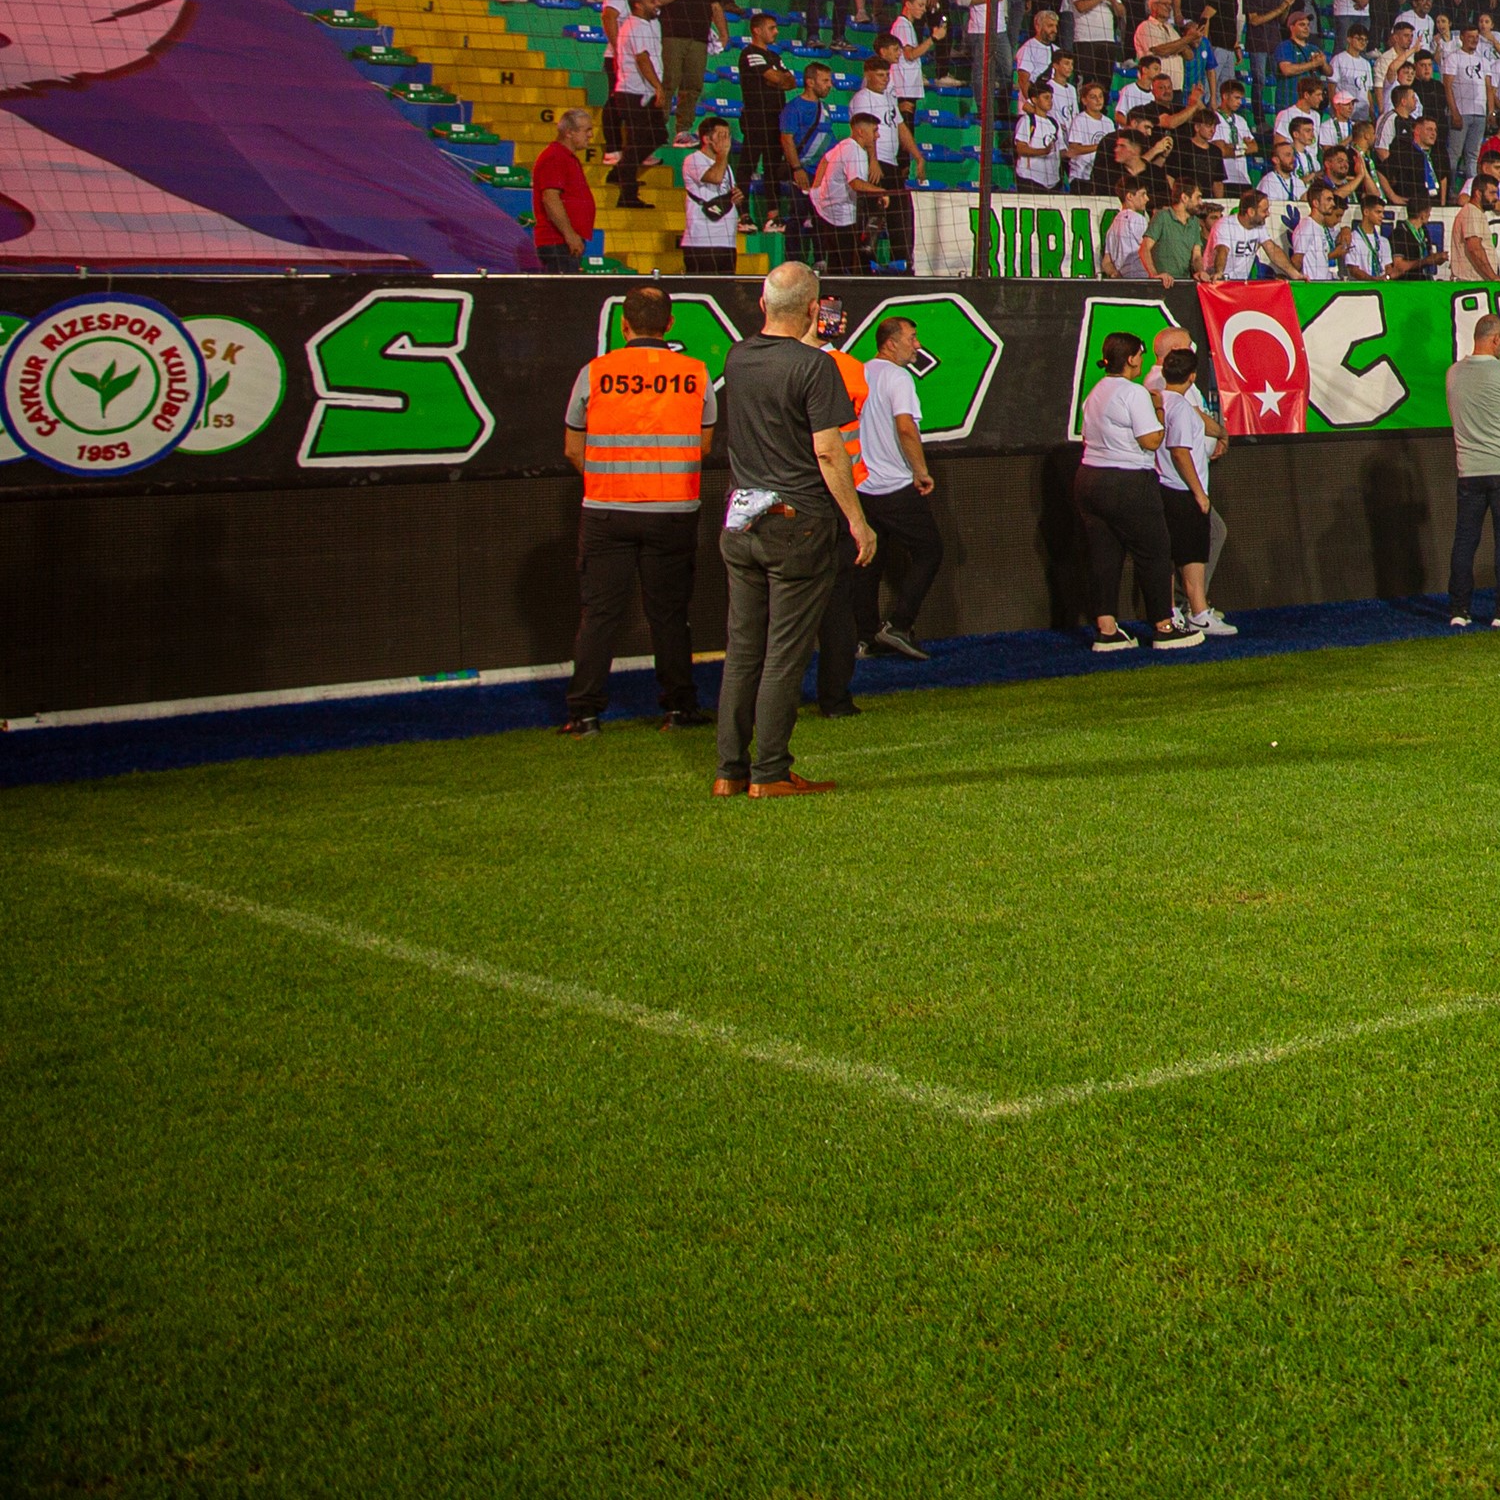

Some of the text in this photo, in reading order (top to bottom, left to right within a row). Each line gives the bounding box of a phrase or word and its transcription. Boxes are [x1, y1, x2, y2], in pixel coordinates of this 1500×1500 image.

[1235, 238, 1258, 255] EA7
[19, 313, 191, 437] ÇAYKUR RİZESPOR KULÜBÜ
[599, 373, 697, 395] 053-016
[77, 441, 131, 462] 1953
